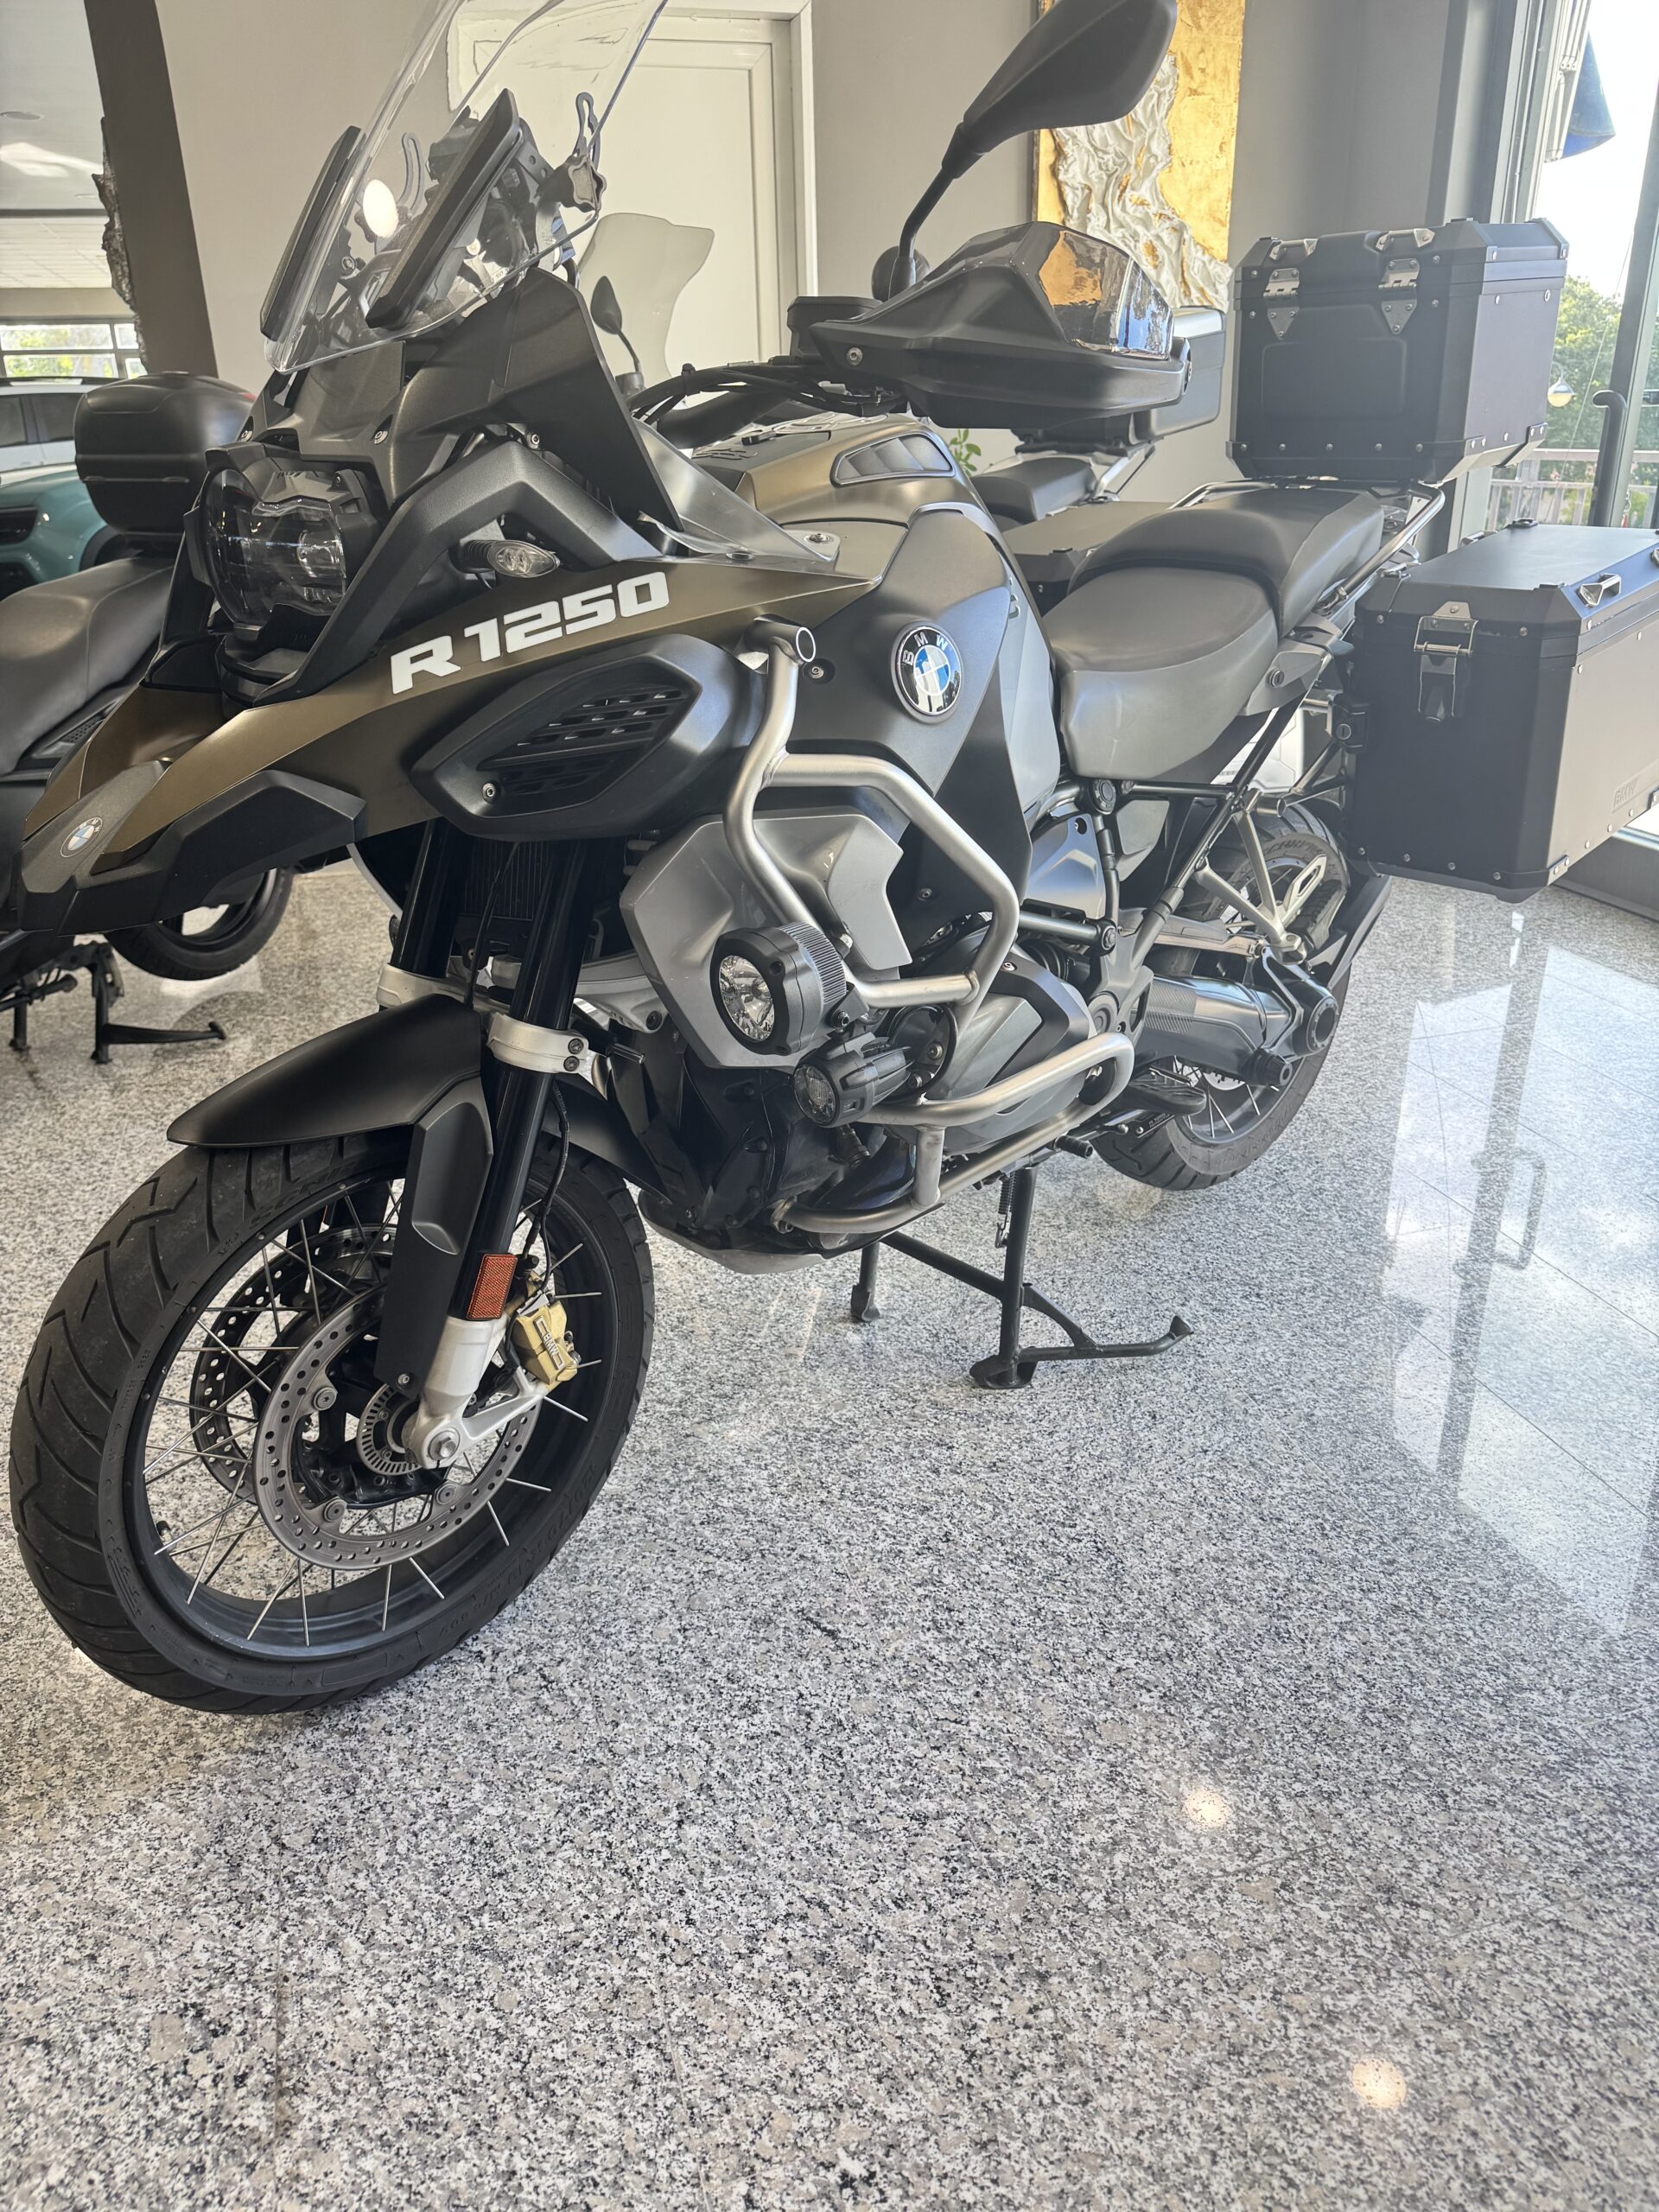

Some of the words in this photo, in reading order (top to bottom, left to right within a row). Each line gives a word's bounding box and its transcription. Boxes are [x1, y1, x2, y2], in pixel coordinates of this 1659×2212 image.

[391, 635, 461, 694] R
[464, 571, 670, 663] 1250
[902, 632, 948, 666] BMW
[1616, 778, 1638, 805] BMW
[79, 818, 102, 832] BMW
[543, 1332, 559, 1355] BMW
